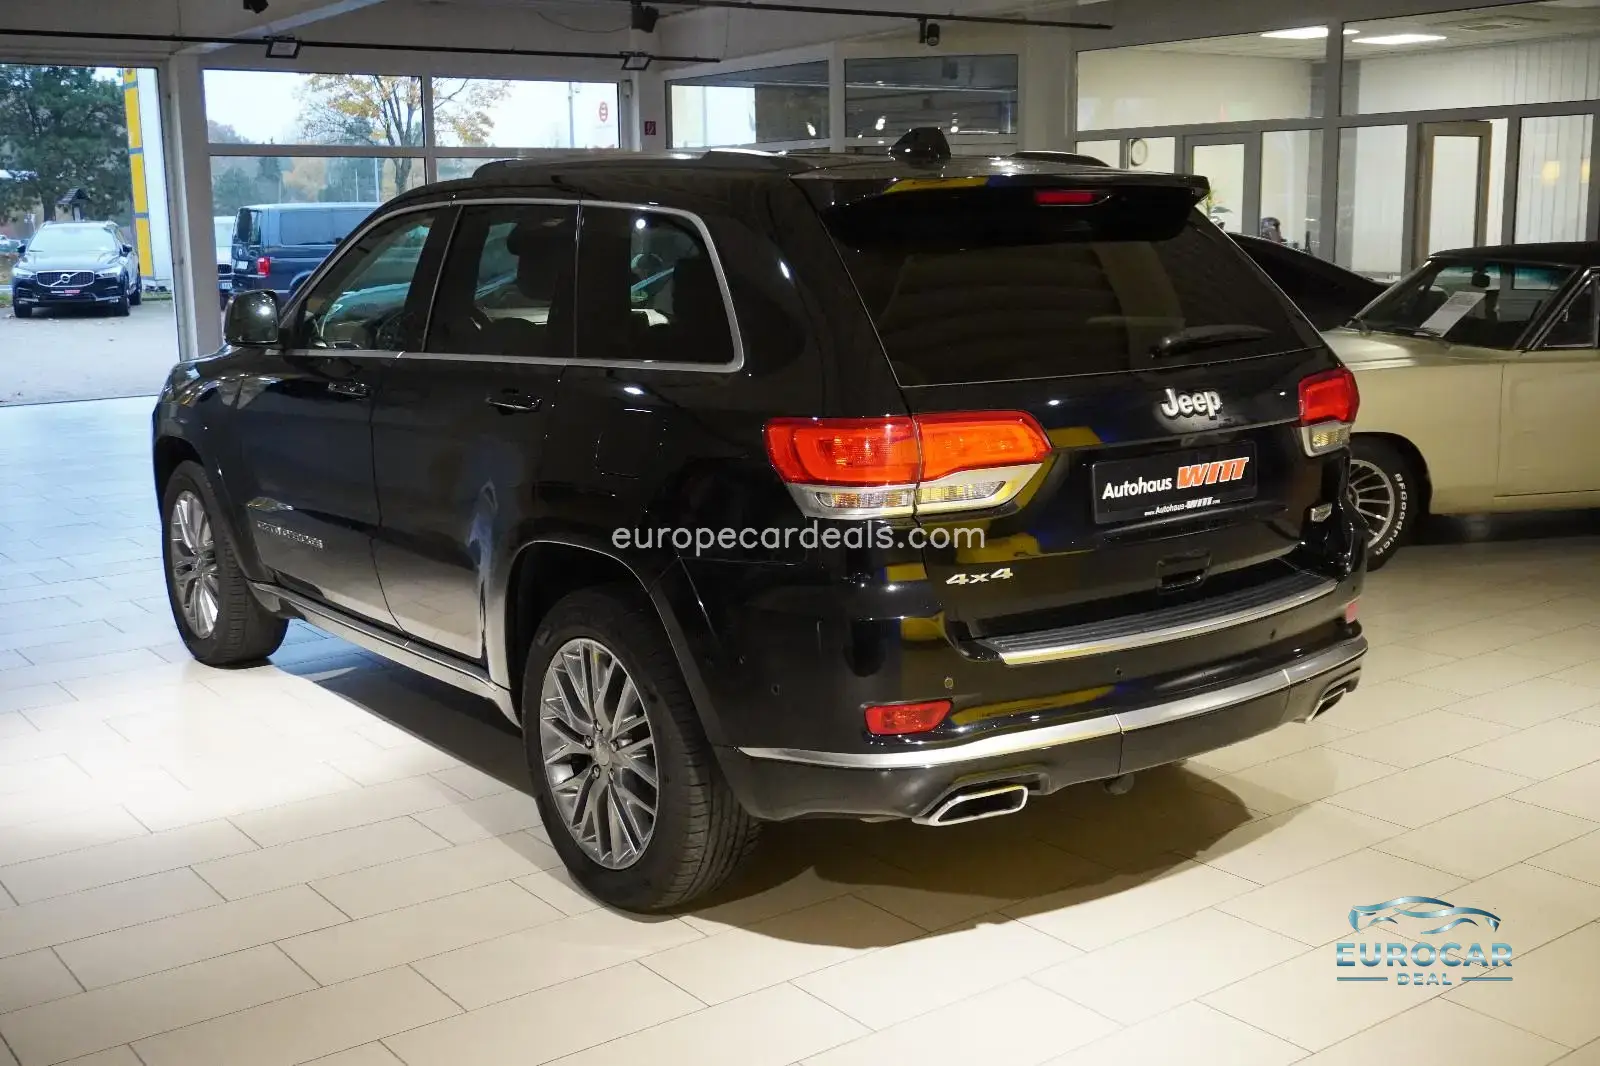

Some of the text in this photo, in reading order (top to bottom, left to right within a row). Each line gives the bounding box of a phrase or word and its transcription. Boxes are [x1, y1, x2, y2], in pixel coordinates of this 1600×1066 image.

[1161, 388, 1221, 418] Jeep
[1102, 456, 1250, 500] Autohaus WITT
[945, 567, 1014, 585] 4x4
